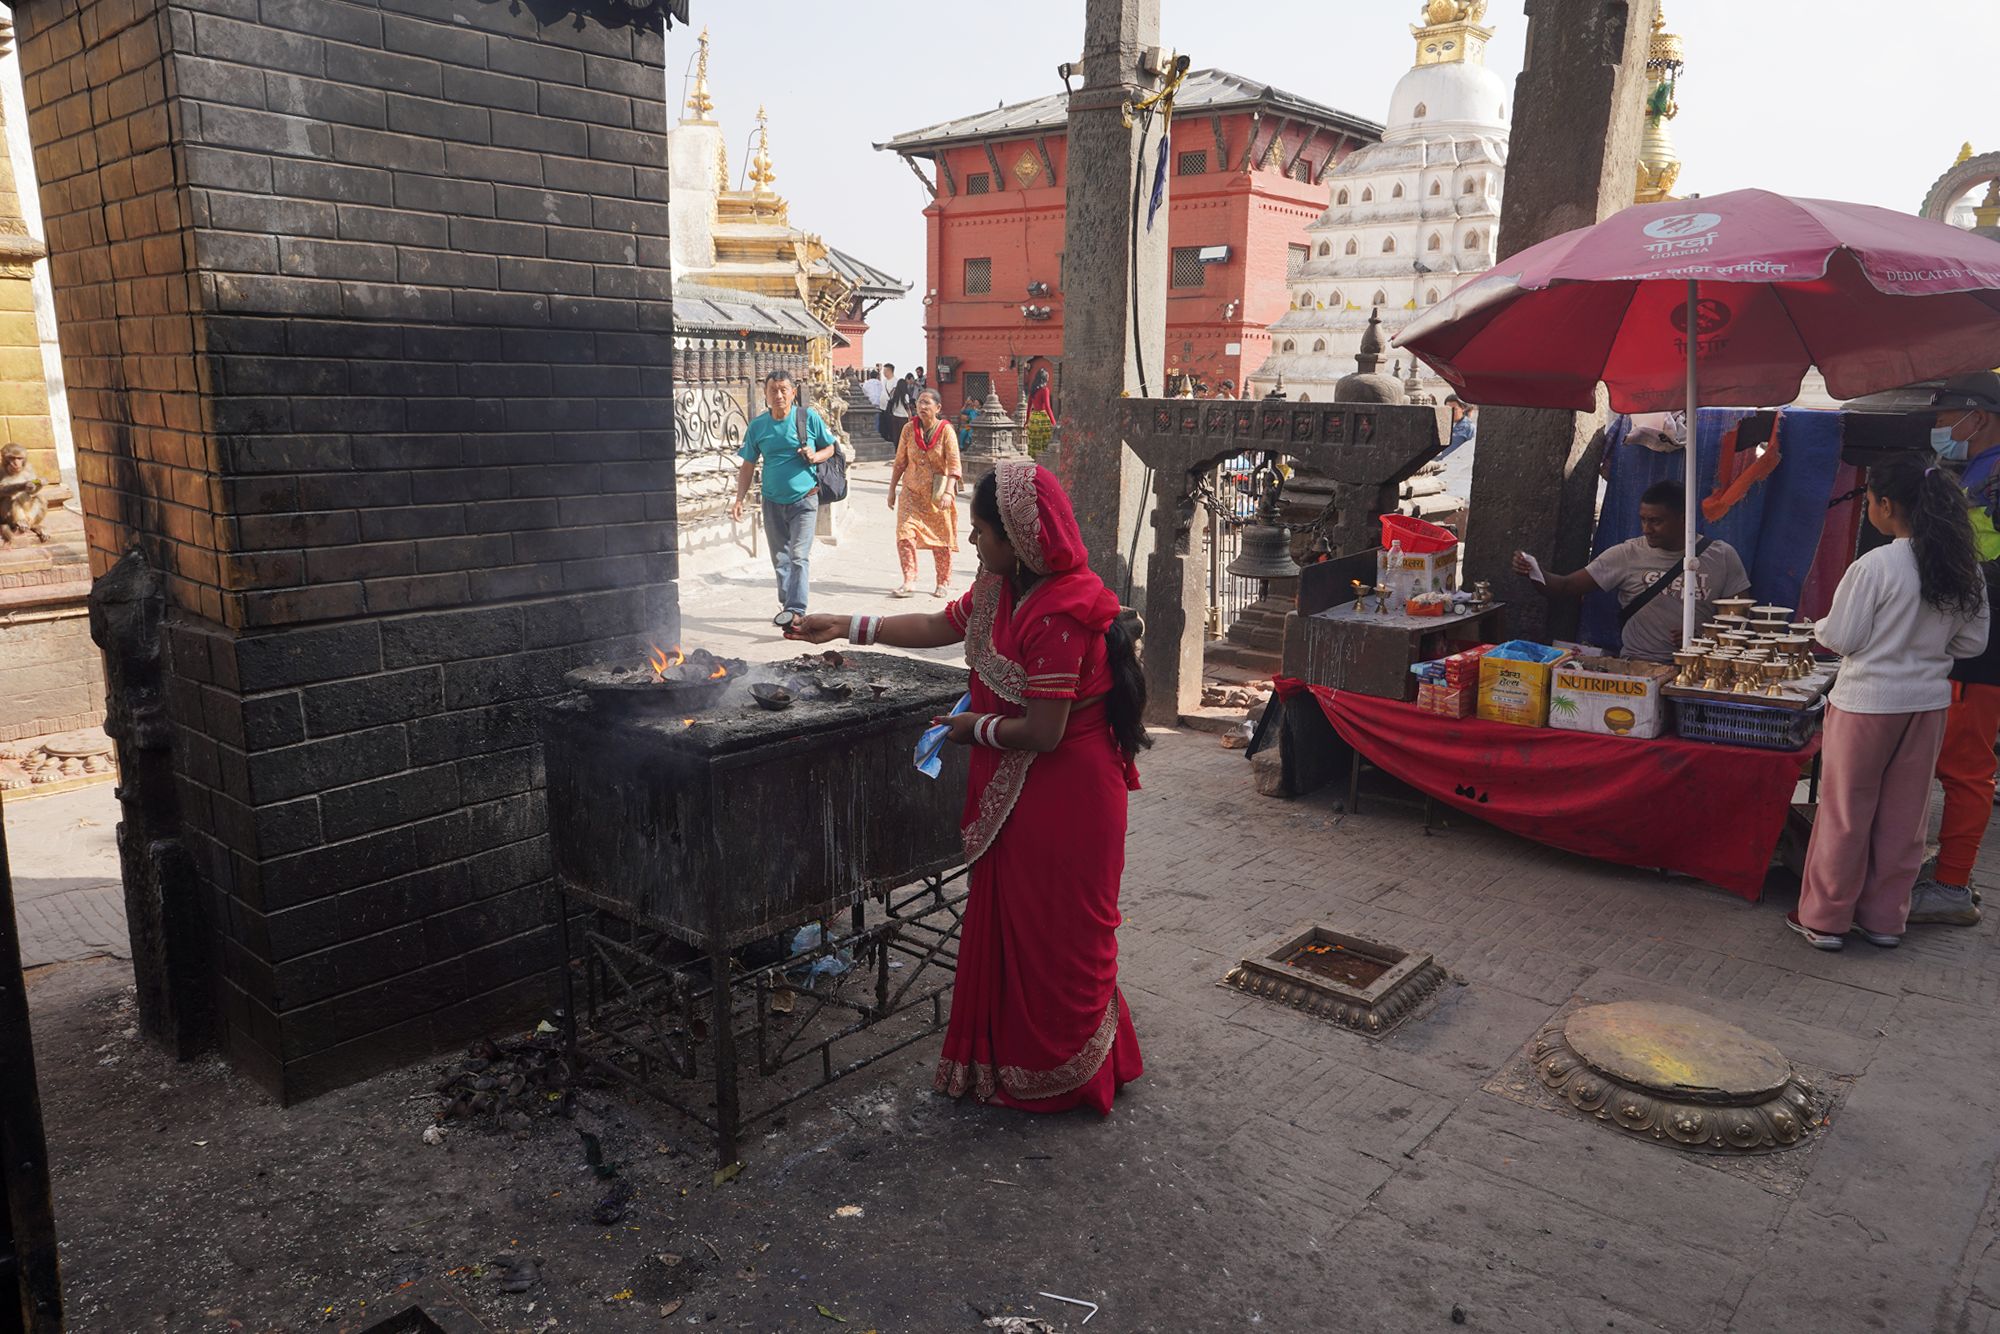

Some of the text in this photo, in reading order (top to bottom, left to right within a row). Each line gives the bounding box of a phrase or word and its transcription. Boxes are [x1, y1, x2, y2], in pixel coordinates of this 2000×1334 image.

[1650, 246, 1710, 260] GORKHA
[1886, 268, 1962, 281] DEDICATED
[1643, 569, 1709, 590] GET
[1560, 674, 1644, 695] NUTRIPLUS
